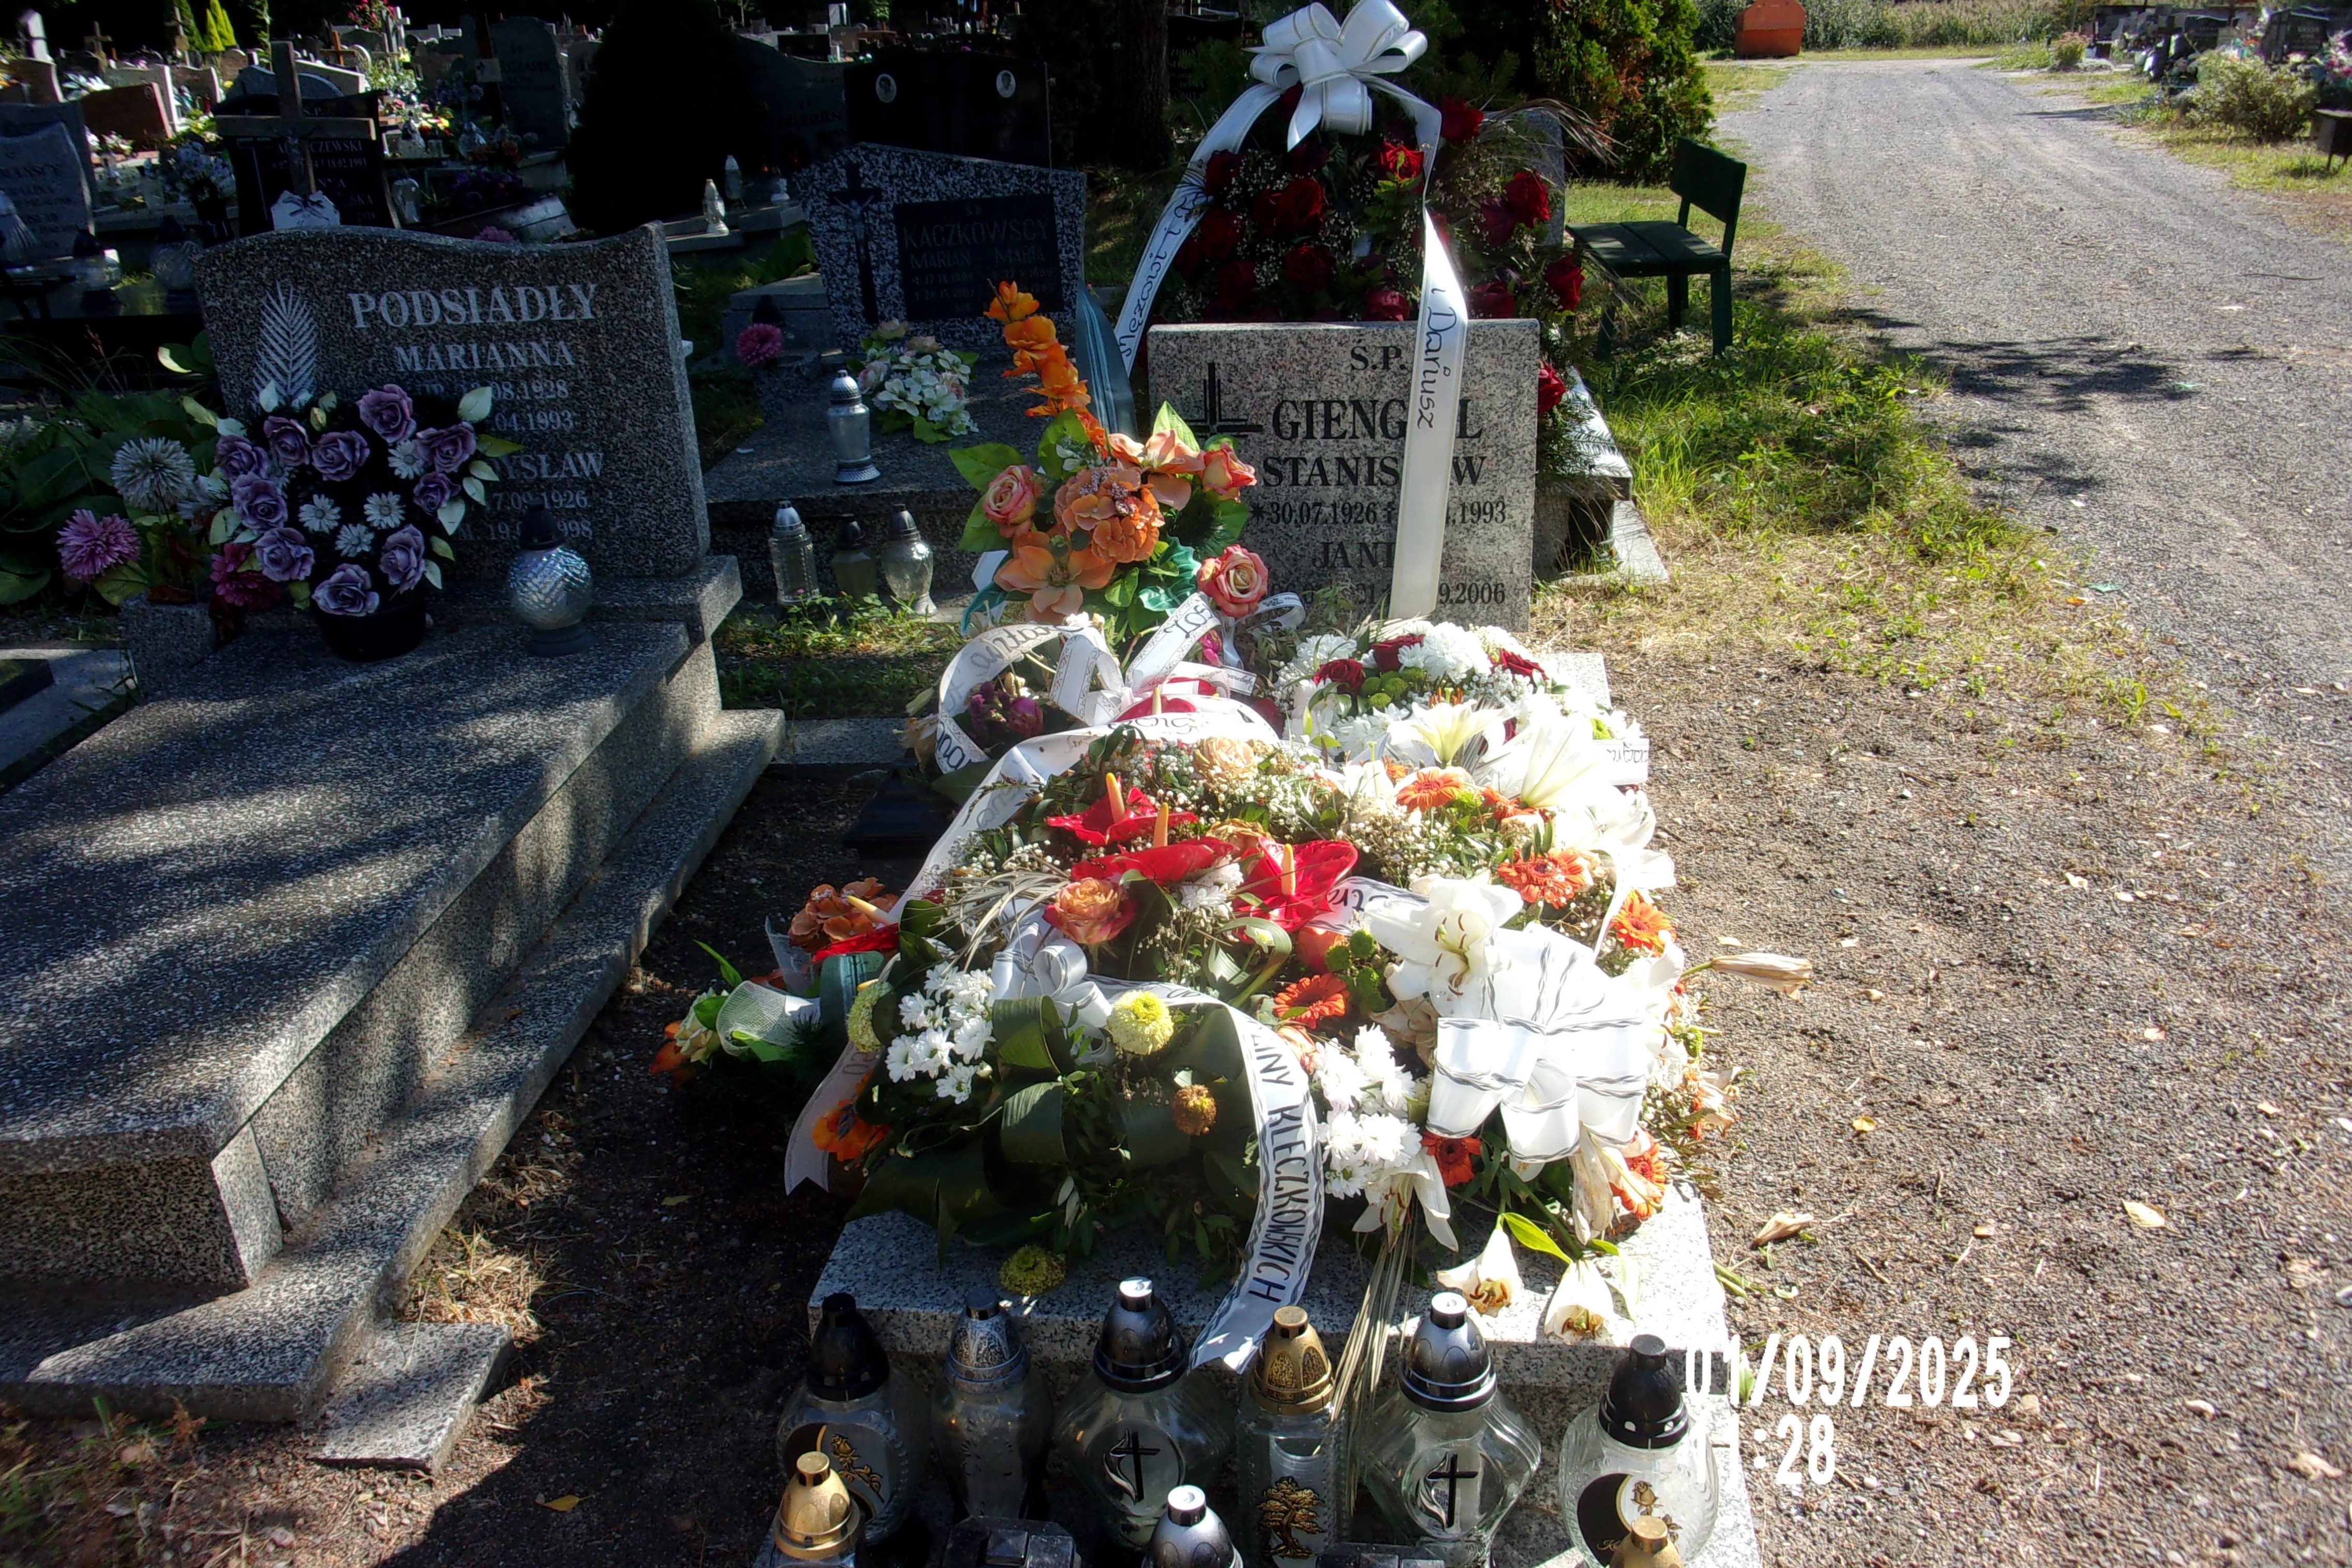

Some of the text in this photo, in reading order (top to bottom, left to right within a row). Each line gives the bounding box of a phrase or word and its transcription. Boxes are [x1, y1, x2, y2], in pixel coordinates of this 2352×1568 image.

[902, 218, 1049, 249] KACZKOWSCY
[910, 249, 972, 269] MARIAN
[349, 283, 598, 328] PODSIADŁY
[395, 339, 575, 372] MARIANNA
[1417, 305, 1457, 430] Dariusz
[1272, 398, 1484, 441] GIENGL
[1262, 455, 1487, 488] STANISW
[1248, 1104, 1309, 1304] KLECZKOWSKICH
